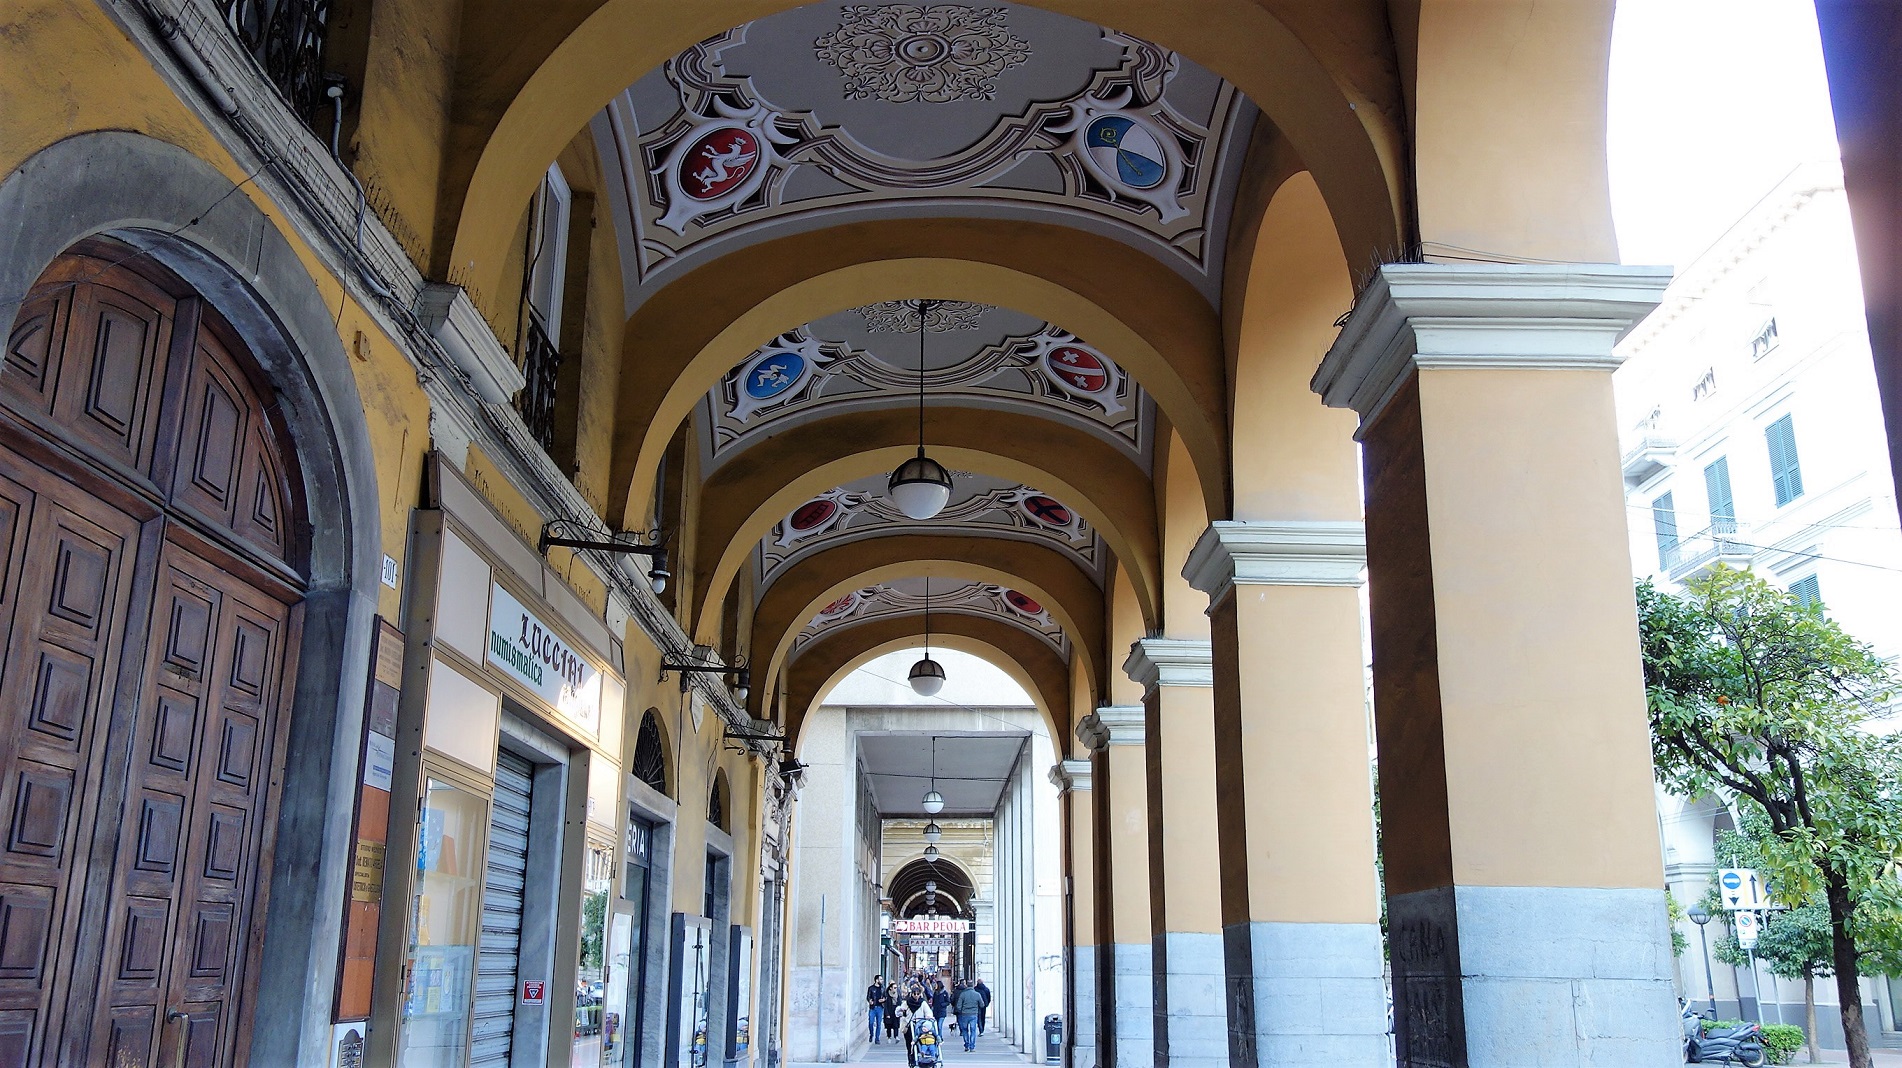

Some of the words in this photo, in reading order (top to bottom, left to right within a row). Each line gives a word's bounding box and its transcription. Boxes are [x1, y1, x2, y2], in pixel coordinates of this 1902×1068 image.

[385, 559, 396, 583] 101
[490, 630, 543, 687] numismatica
[909, 922, 930, 931] BAR
[933, 922, 966, 931] PEOLA
